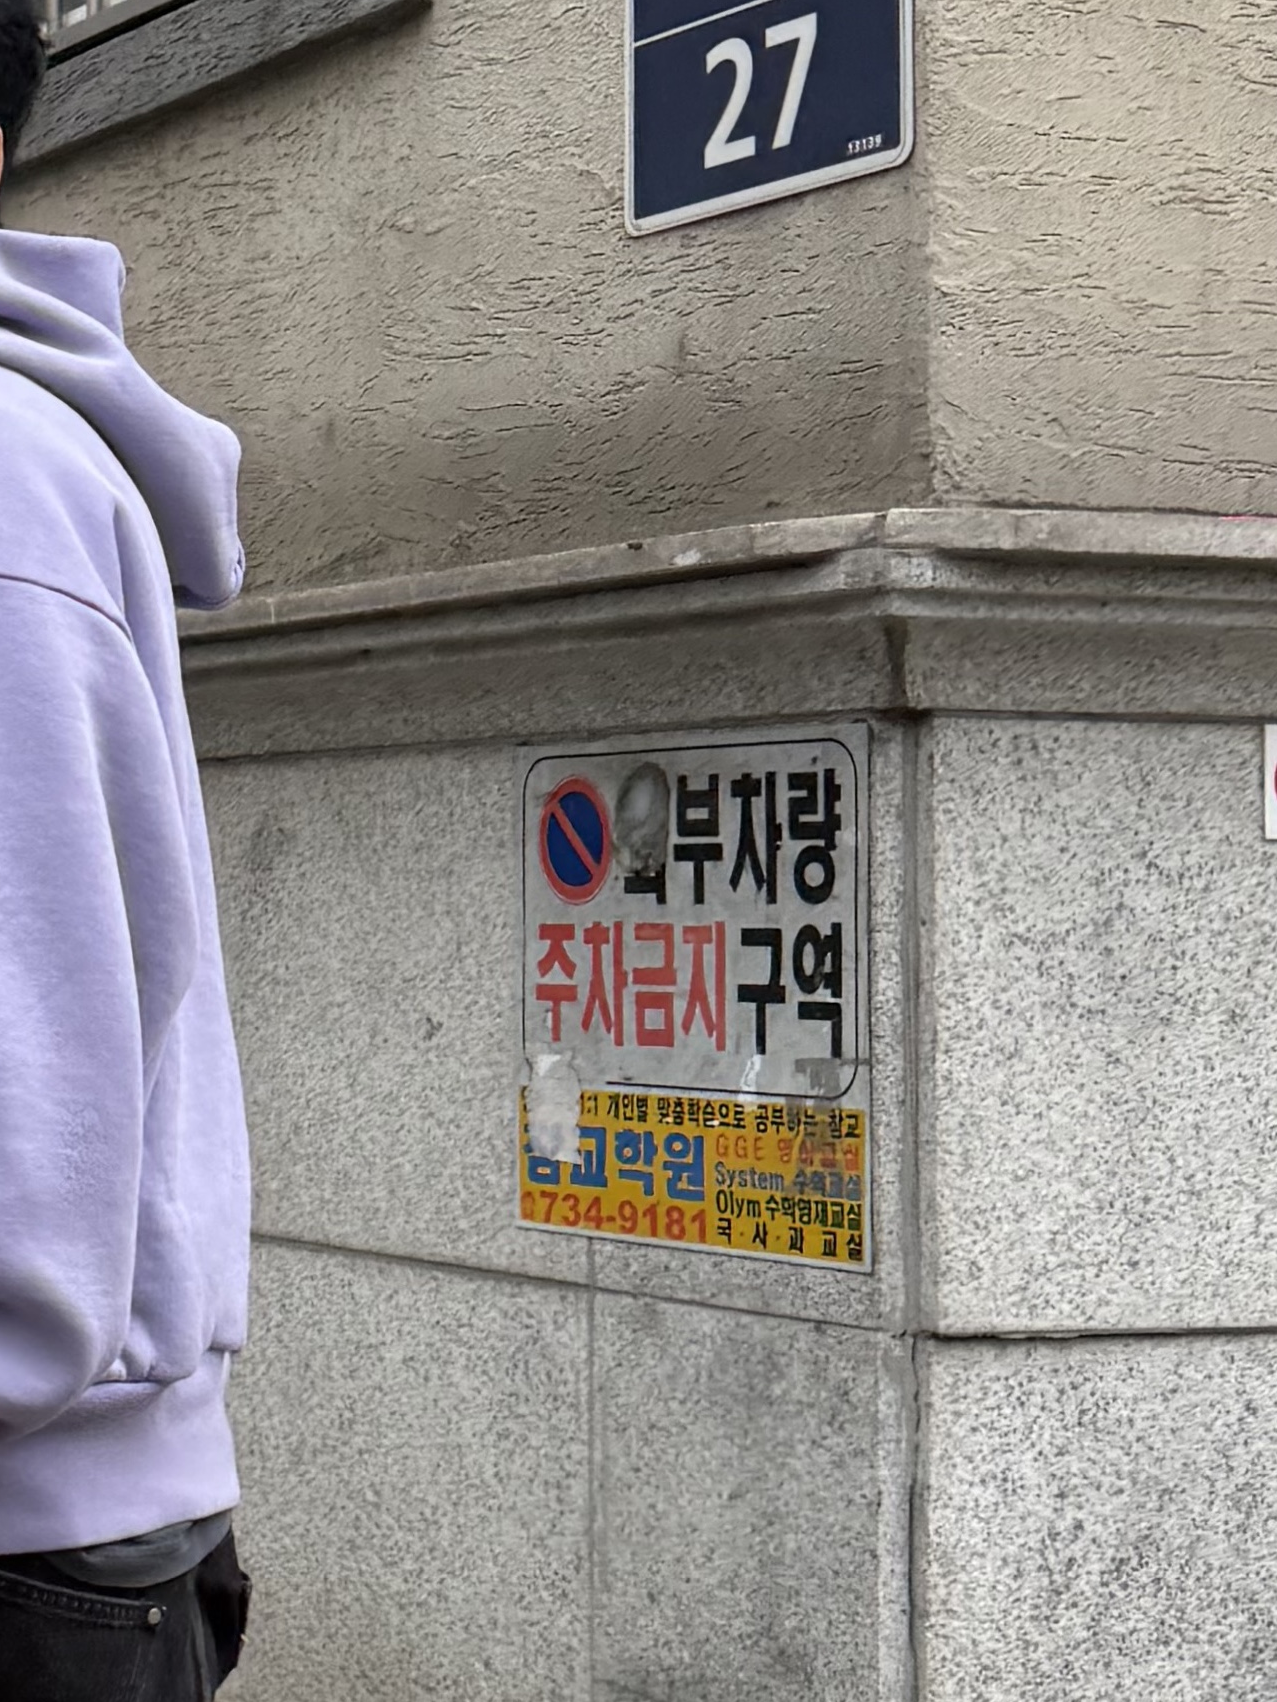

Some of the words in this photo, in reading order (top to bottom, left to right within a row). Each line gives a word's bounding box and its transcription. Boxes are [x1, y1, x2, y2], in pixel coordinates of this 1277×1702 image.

[703, 11, 818, 170] 27
[624, 767, 843, 906] 부차량
[714, 1160, 785, 1193] System
[715, 1189, 762, 1221] Olym
